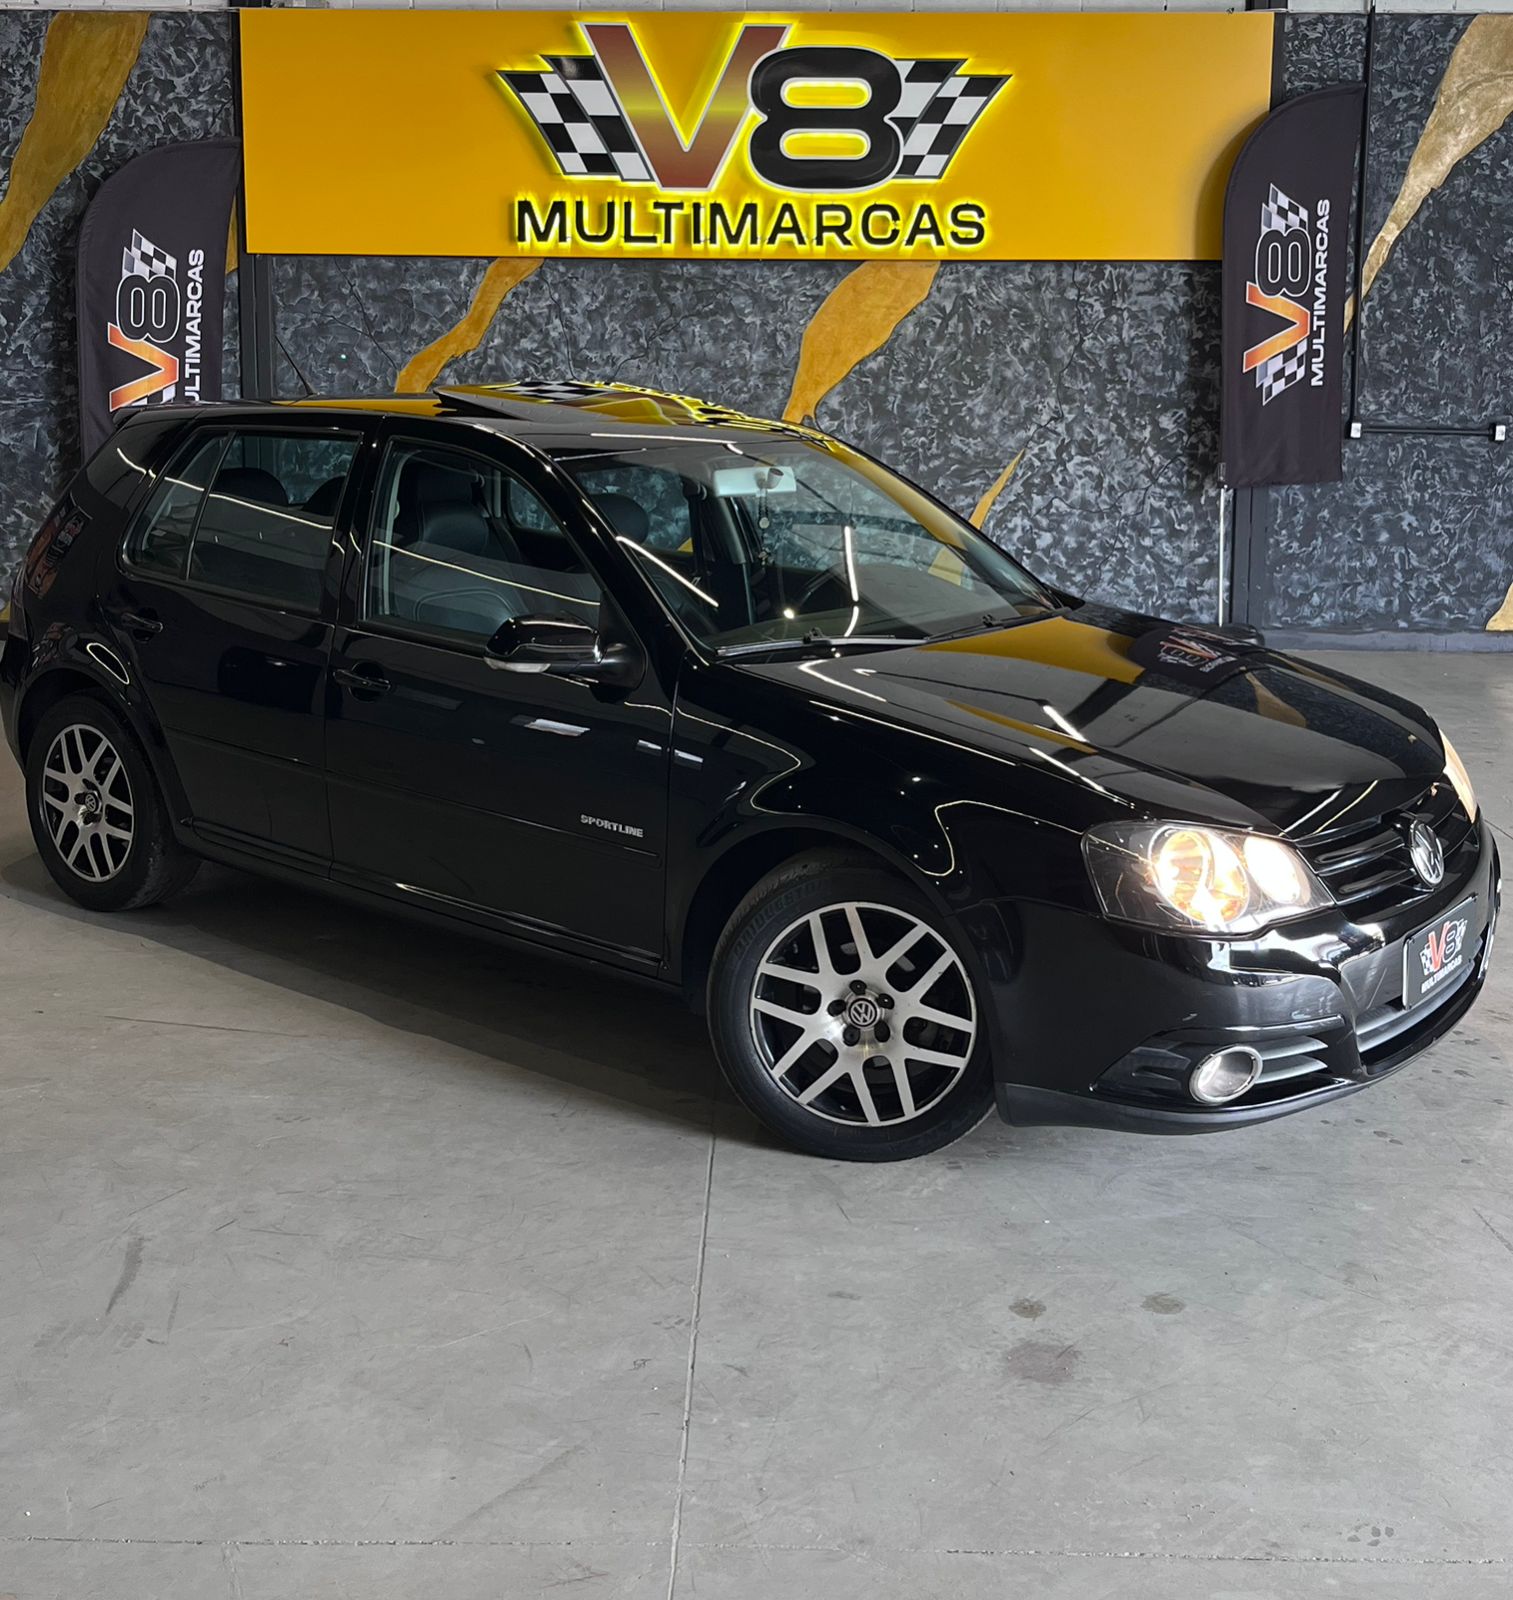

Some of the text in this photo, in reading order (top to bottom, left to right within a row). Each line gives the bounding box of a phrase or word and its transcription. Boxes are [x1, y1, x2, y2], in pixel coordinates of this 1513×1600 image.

[578, 22, 904, 193] V8
[517, 200, 986, 247] MULTIMARCAS
[1311, 199, 1331, 387] MULTIMARCAS
[108, 274, 181, 412] V8
[184, 249, 205, 402] ULTIMARCAS
[1243, 226, 1312, 374] V8
[580, 813, 644, 838] SPORTLINE
[1428, 920, 1459, 972] V8
